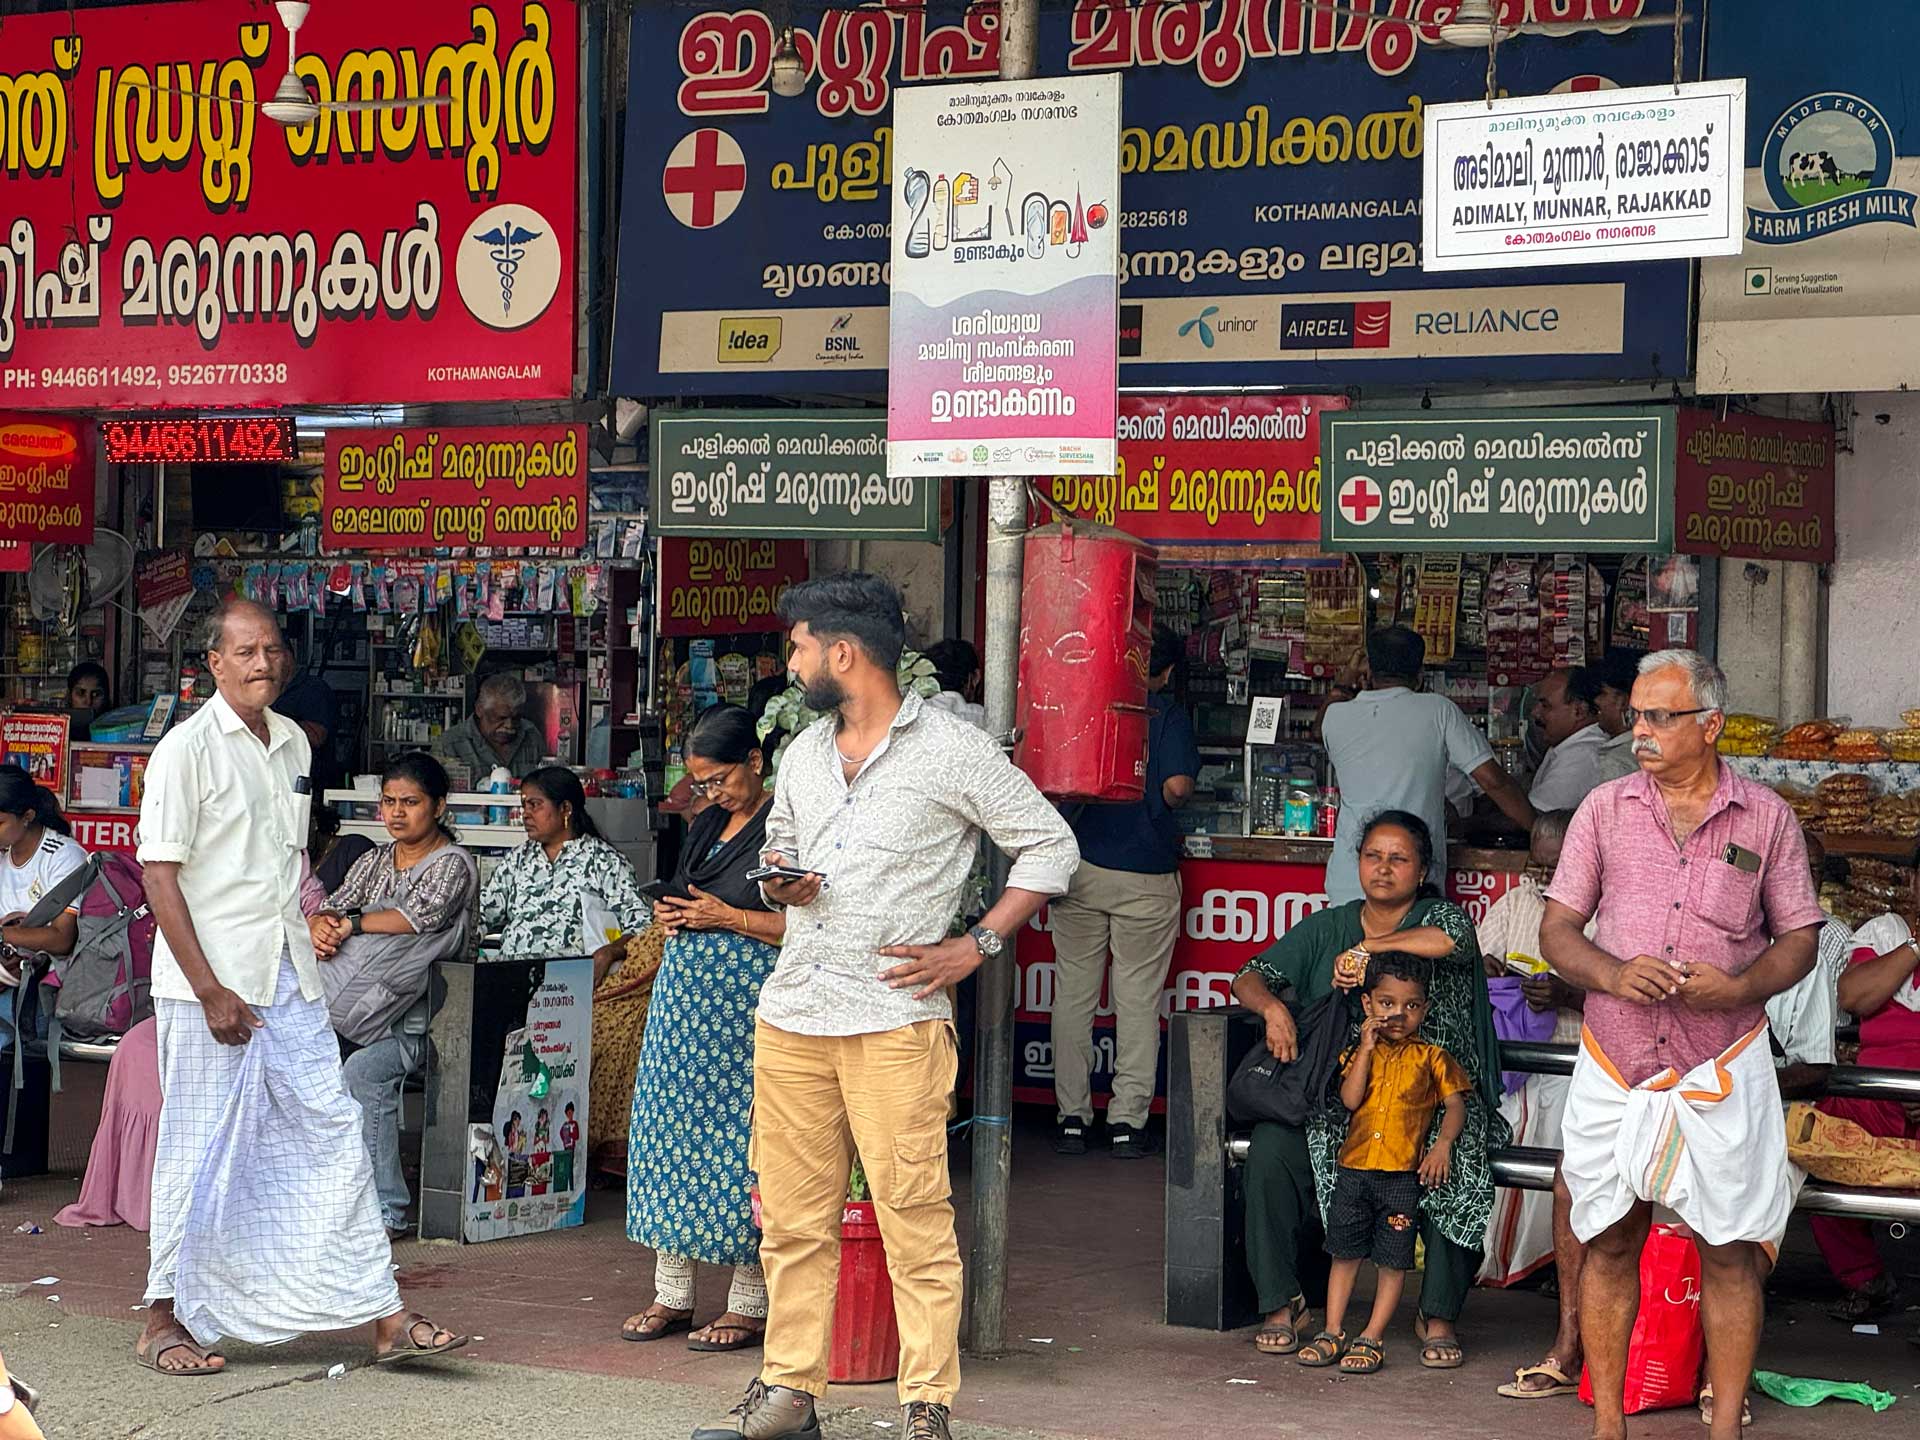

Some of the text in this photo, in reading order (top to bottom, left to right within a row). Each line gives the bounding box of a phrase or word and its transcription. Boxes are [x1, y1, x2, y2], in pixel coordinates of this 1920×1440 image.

[937, 105, 1078, 127] കോതമംഗലം നഗരസഭ
[1592, 107, 1675, 124] നവകേരളം
[1777, 99, 1879, 139] MADE FROM
[1453, 122, 1714, 195] അടിമാലി, മൂന്നാർ, രാജാക്കാട്
[1452, 188, 1711, 227] ADIMALY, MUNNAR, RAJAKKAD
[1754, 195, 1910, 237] FARM FRESH MILK
[1504, 224, 1656, 246] കോതമംഗലം നഗരസഭ
[121, 202, 442, 344] മരുന്നുകൾ
[1774, 272, 1838, 285] Serving Suggestion
[1774, 284, 1843, 295] Creative Visualization
[952, 309, 1041, 336] ശരിയായ
[1217, 316, 1258, 333] uninor
[1286, 320, 1348, 338] AIRCEL
[825, 337, 861, 351] BSNL
[4, 363, 287, 391] PH: 9446611492, 9526770338
[427, 365, 542, 381] KOTHAMANGALAM
[963, 362, 1053, 385] ശീലങ്ങളും
[931, 388, 1076, 423] ഉണ്ടാകണം
[1172, 406, 1311, 440] മെഡിക്കൽസ്
[110, 424, 284, 458] 9446611492
[681, 433, 888, 460] പുളിക്കൽ മെഡിക്കൽ
[1345, 431, 1648, 467] പുളിക്കൽ മെഡിക്കൽസ്
[1687, 423, 1746, 465] പുളിക്കൽ
[339, 430, 577, 494] ഇംഗ്ലീഷ് മരുന്നുകൾ
[671, 462, 771, 517] ഇംഗ്ലീഷ്
[1169, 456, 1321, 526] മരുന്നുകൾ
[1388, 466, 1648, 528] ഇംഗ്ലീഷ് മരുന്നുകൾ
[1708, 471, 1808, 516] ഇംഗ്ലീഷ്
[331, 498, 431, 534] മേലേത്ത്
[1686, 512, 1822, 553] മരുന്നുകൾ
